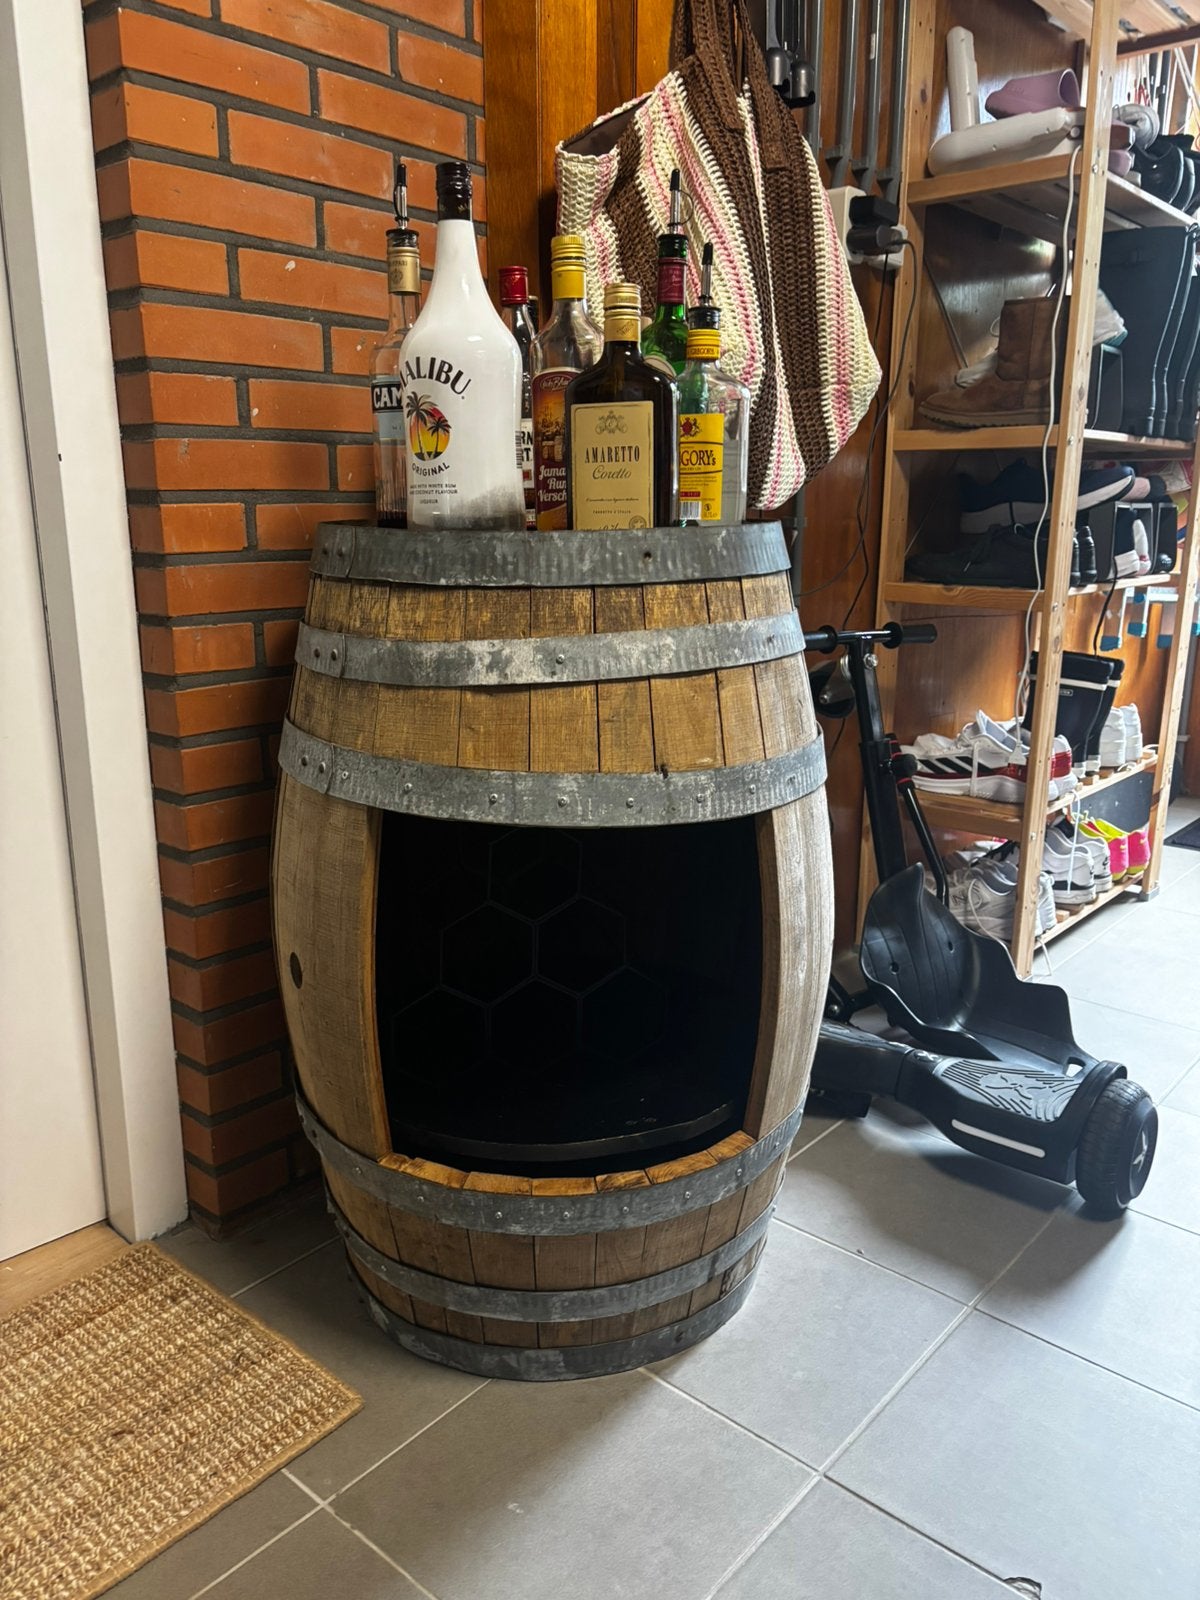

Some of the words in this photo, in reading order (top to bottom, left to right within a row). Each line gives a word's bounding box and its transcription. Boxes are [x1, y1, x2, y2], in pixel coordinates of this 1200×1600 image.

[585, 446, 641, 463] AMARETTO
[411, 462, 450, 477] ORIGINAL
[592, 464, 632, 480] Coretto
